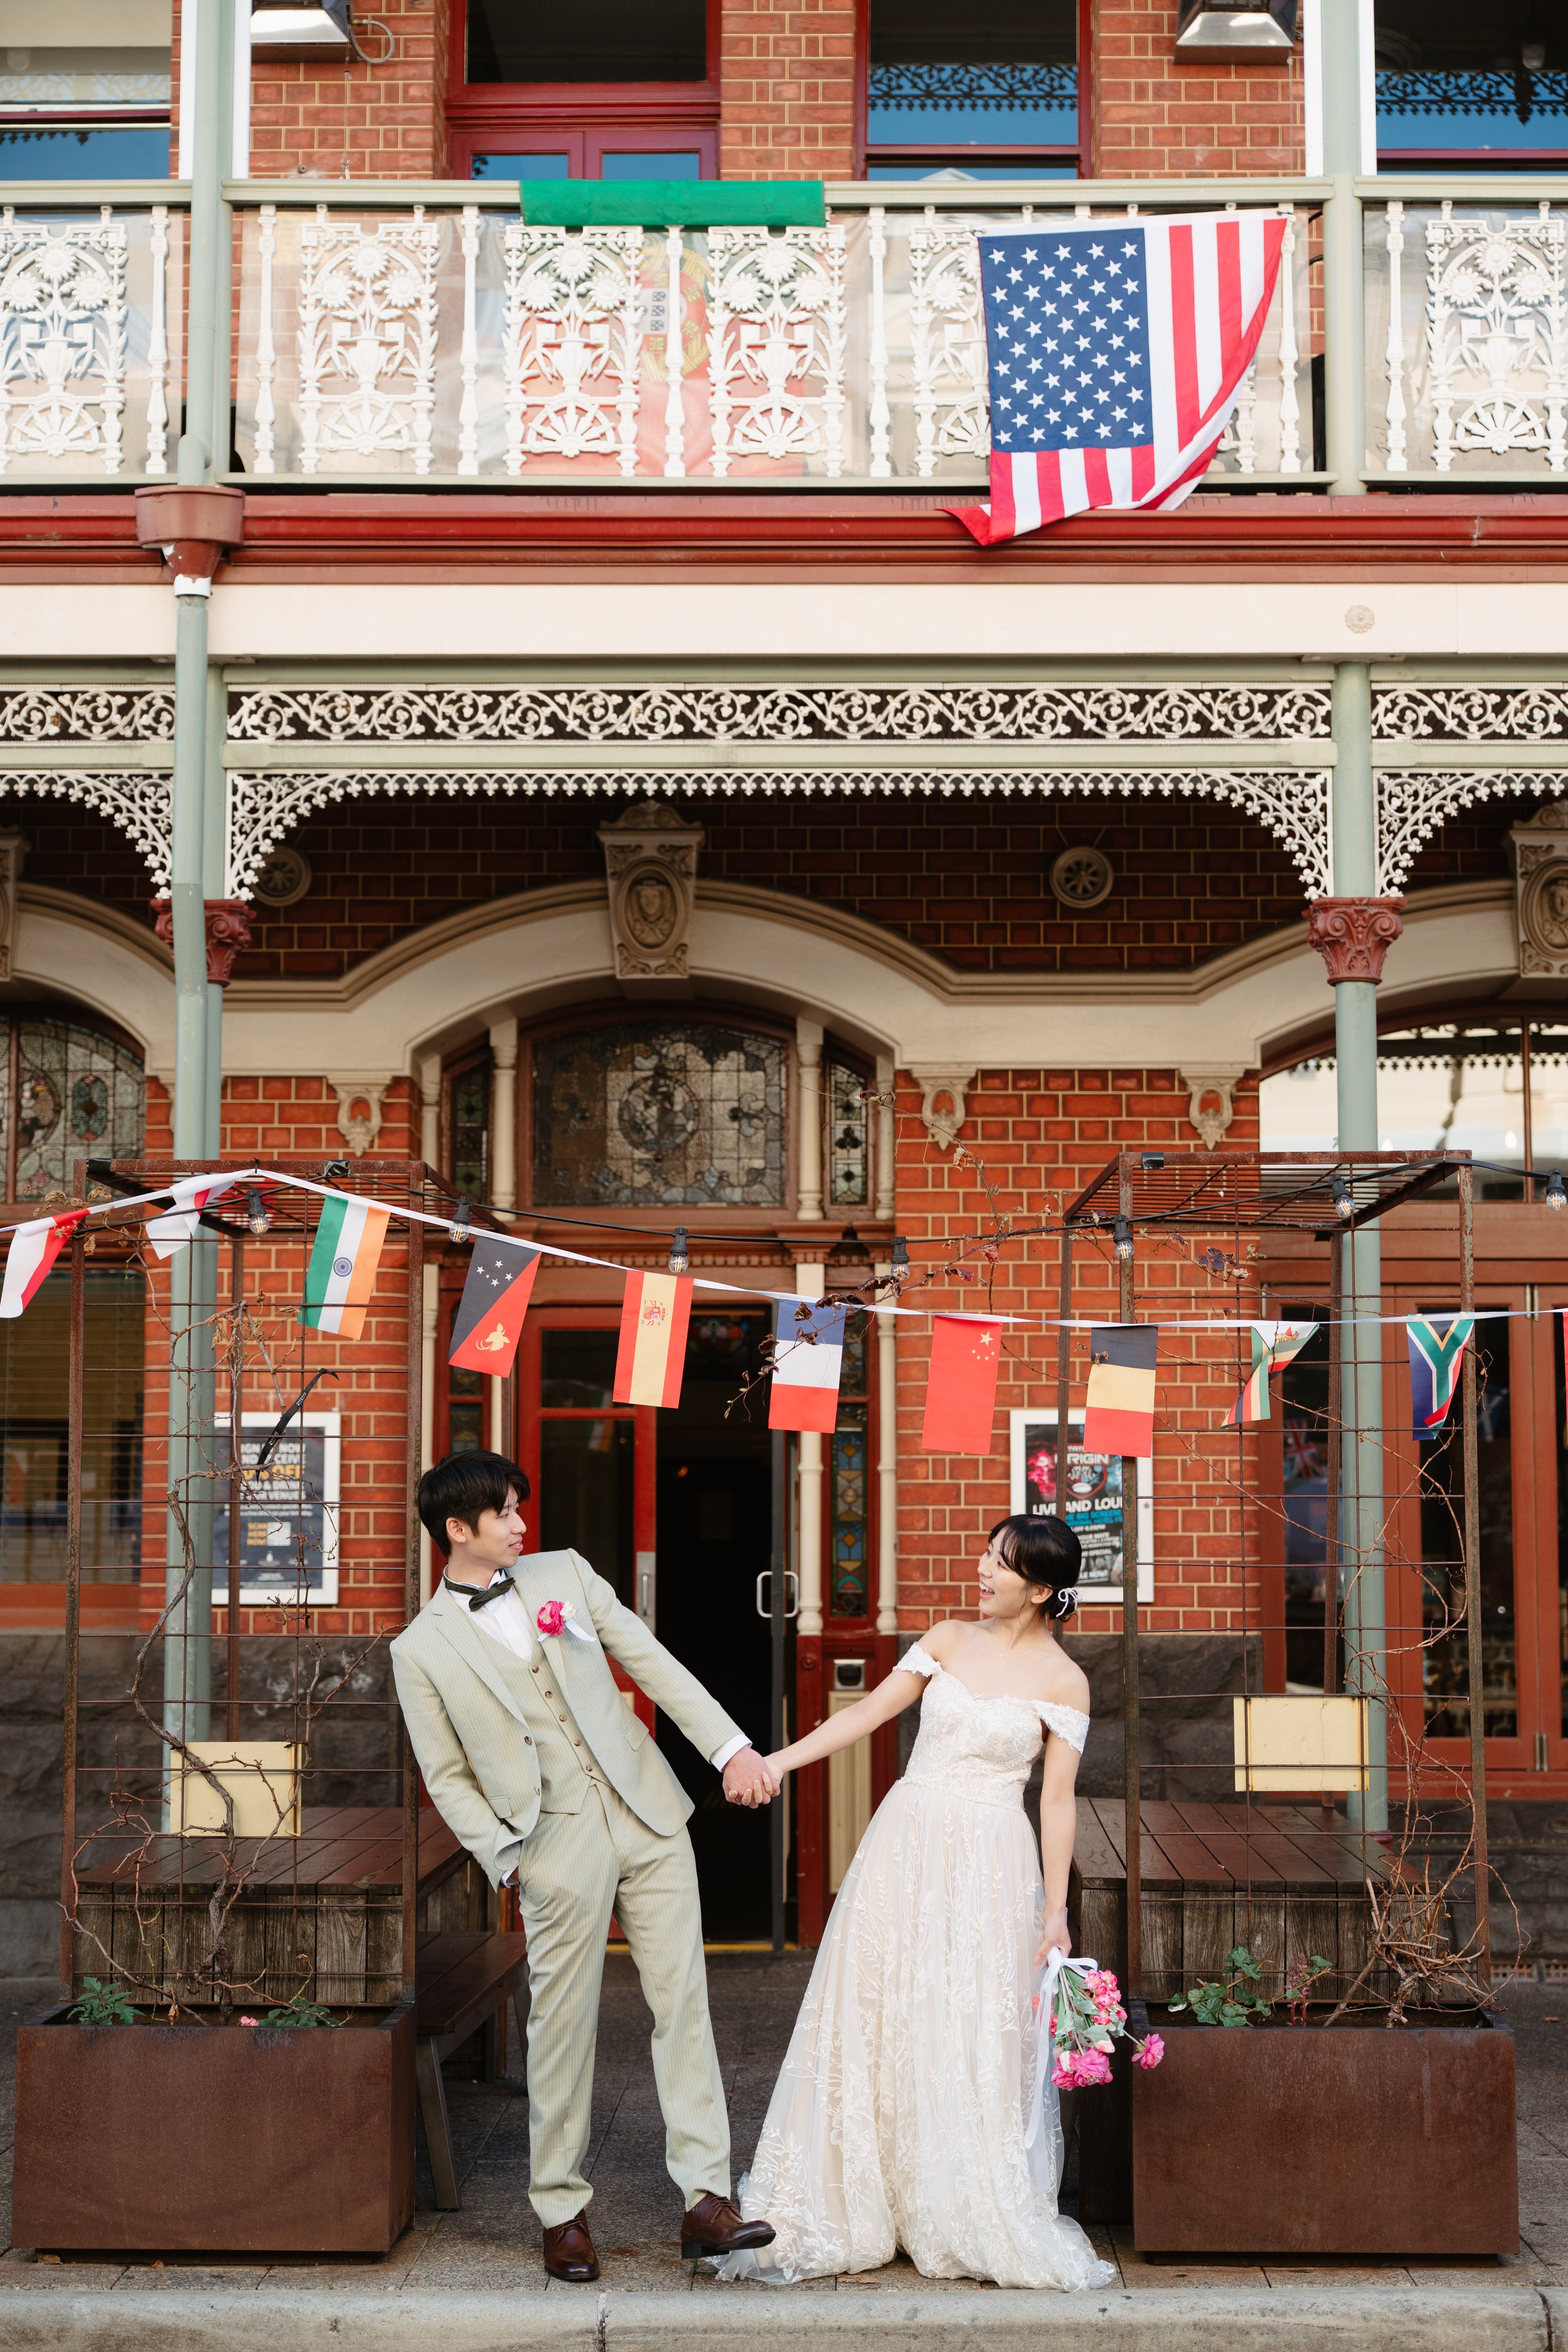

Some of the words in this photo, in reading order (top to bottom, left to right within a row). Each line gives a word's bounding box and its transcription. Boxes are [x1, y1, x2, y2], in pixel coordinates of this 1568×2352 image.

[240, 1442, 260, 1454] IGN
[272, 1464, 306, 1480] OFF
[1065, 1499, 1092, 1513] AND
[1076, 1512, 1089, 1520] BIG
